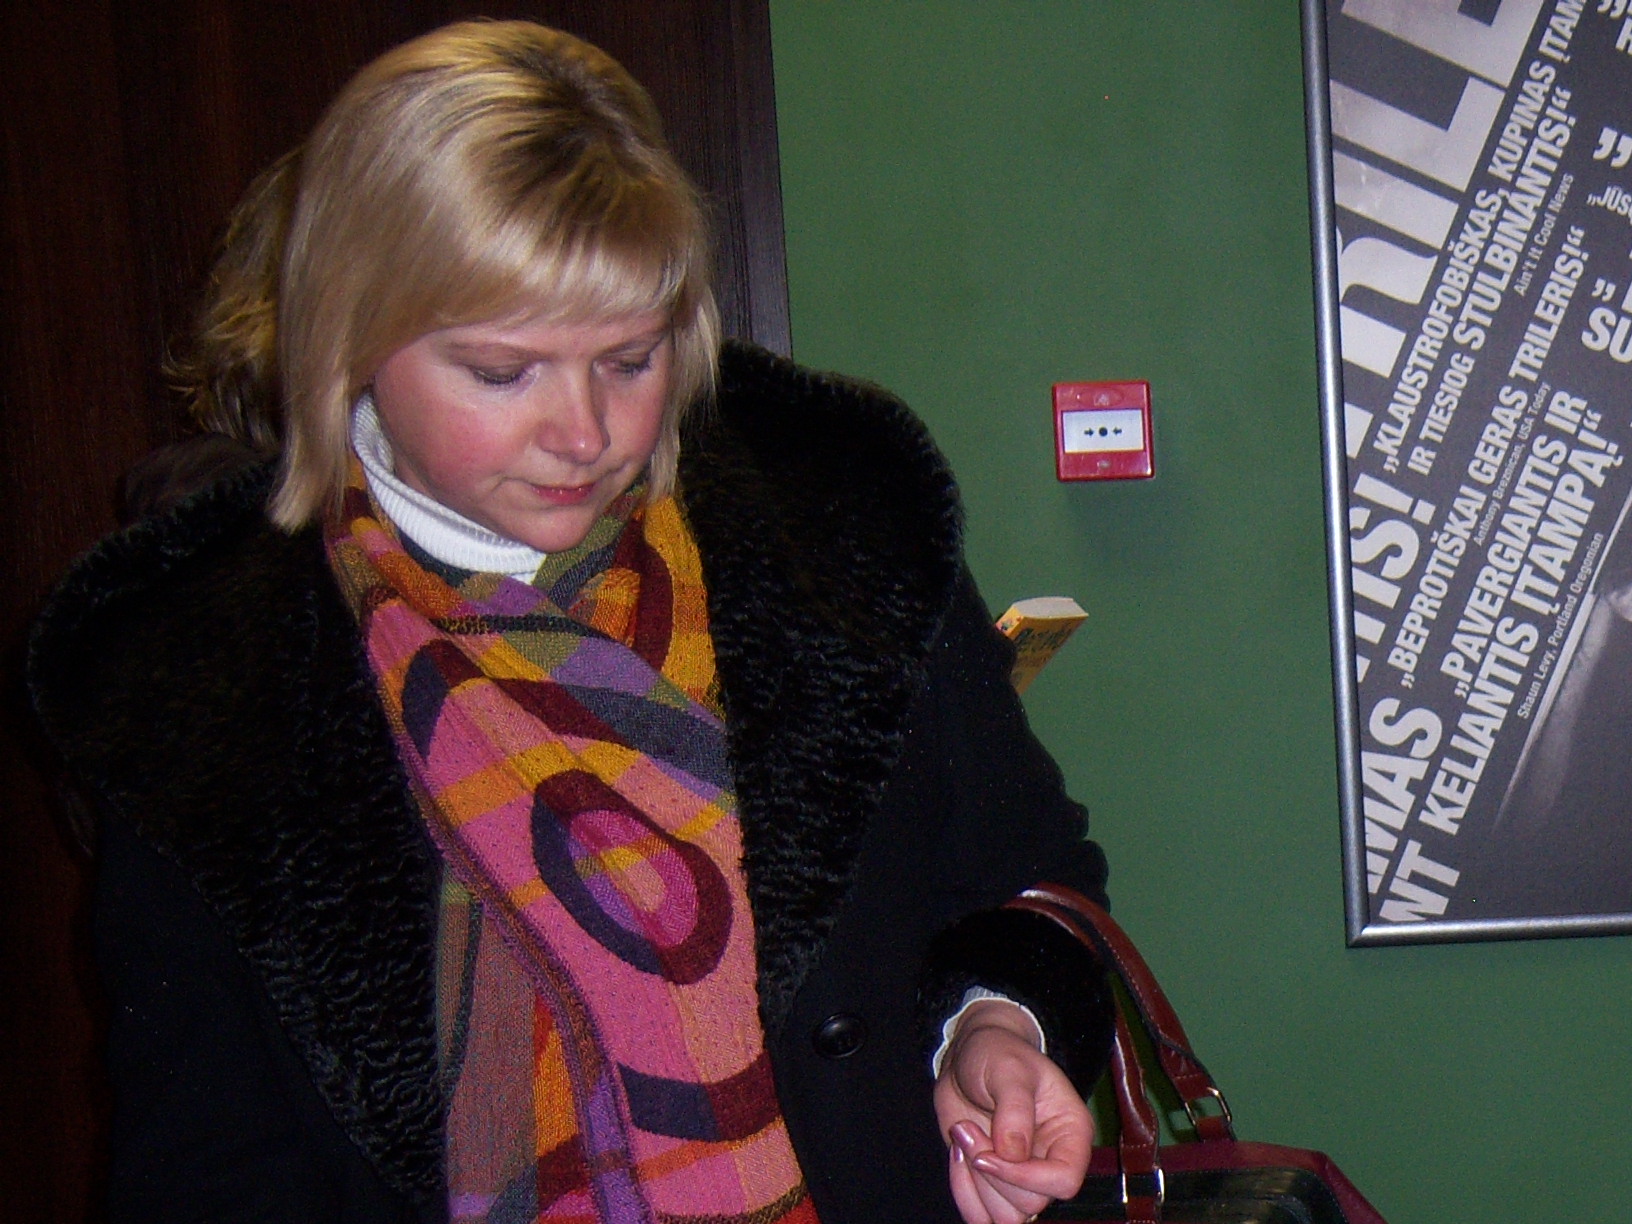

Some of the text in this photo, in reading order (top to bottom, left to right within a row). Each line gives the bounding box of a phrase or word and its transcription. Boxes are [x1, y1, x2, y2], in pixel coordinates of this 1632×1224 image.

[1487, 60, 1557, 182] KUPINAS
[1547, 173, 1574, 206] News
[1407, 445, 1437, 476] IR
[1419, 351, 1476, 443] TIESIOG
[1473, 500, 1501, 546] Anthony
[1516, 416, 1532, 441] USA
[1528, 380, 1551, 417] Today
[1387, 485, 1487, 690] „BEPROTIŠKAI
[1467, 385, 1529, 487] GERAS
[1440, 390, 1588, 700] „PAVERGIANTIS IR
[1516, 680, 1542, 721] Shaun
[1547, 593, 1578, 648] Portland
[1568, 531, 1605, 596] Oregonian
[1418, 615, 1540, 836] KELIANTIS
